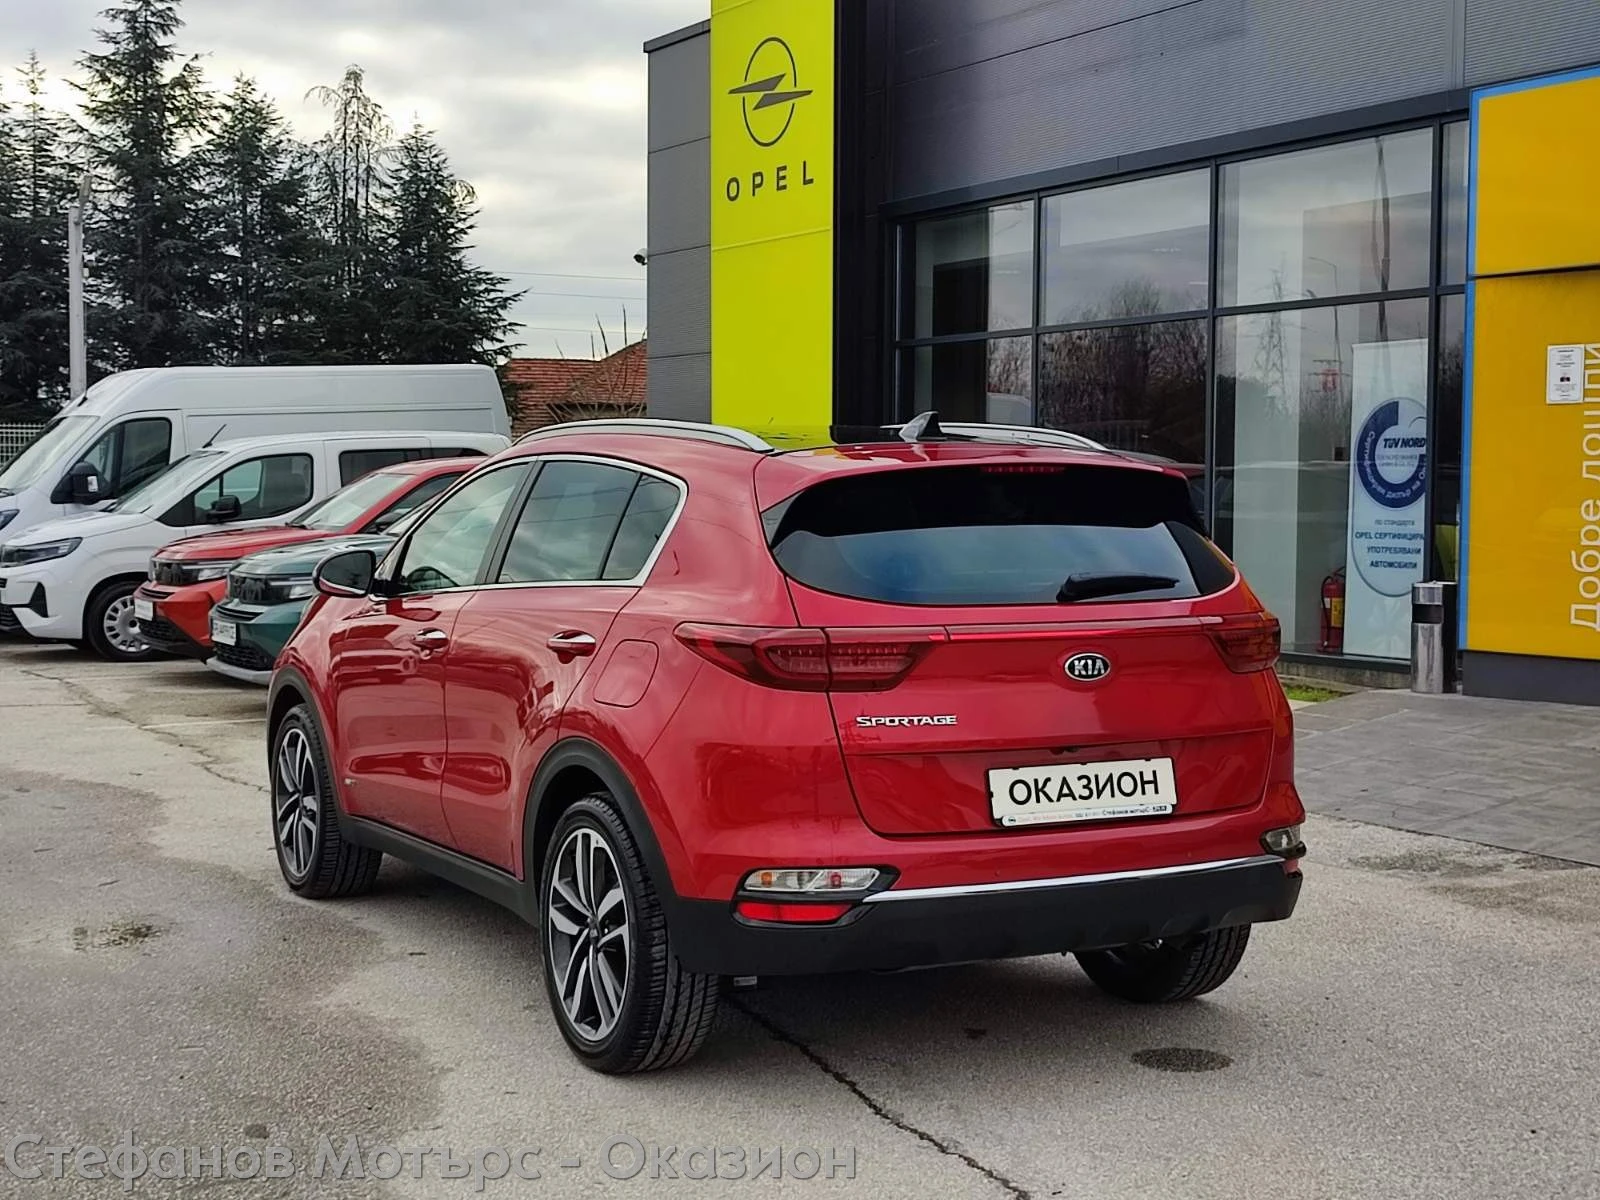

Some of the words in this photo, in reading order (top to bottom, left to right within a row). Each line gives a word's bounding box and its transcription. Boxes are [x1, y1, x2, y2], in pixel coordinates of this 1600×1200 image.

[727, 161, 814, 202] OPEL
[1400, 437, 1426, 449] NORD
[1354, 531, 1374, 540] OPEL
[1369, 560, 1418, 569] АВТОМОБИЛИ
[1570, 499, 1600, 632] Добре
[856, 714, 958, 728] SPORTAGE
[1008, 769, 1160, 806] ОКАЗИОН
